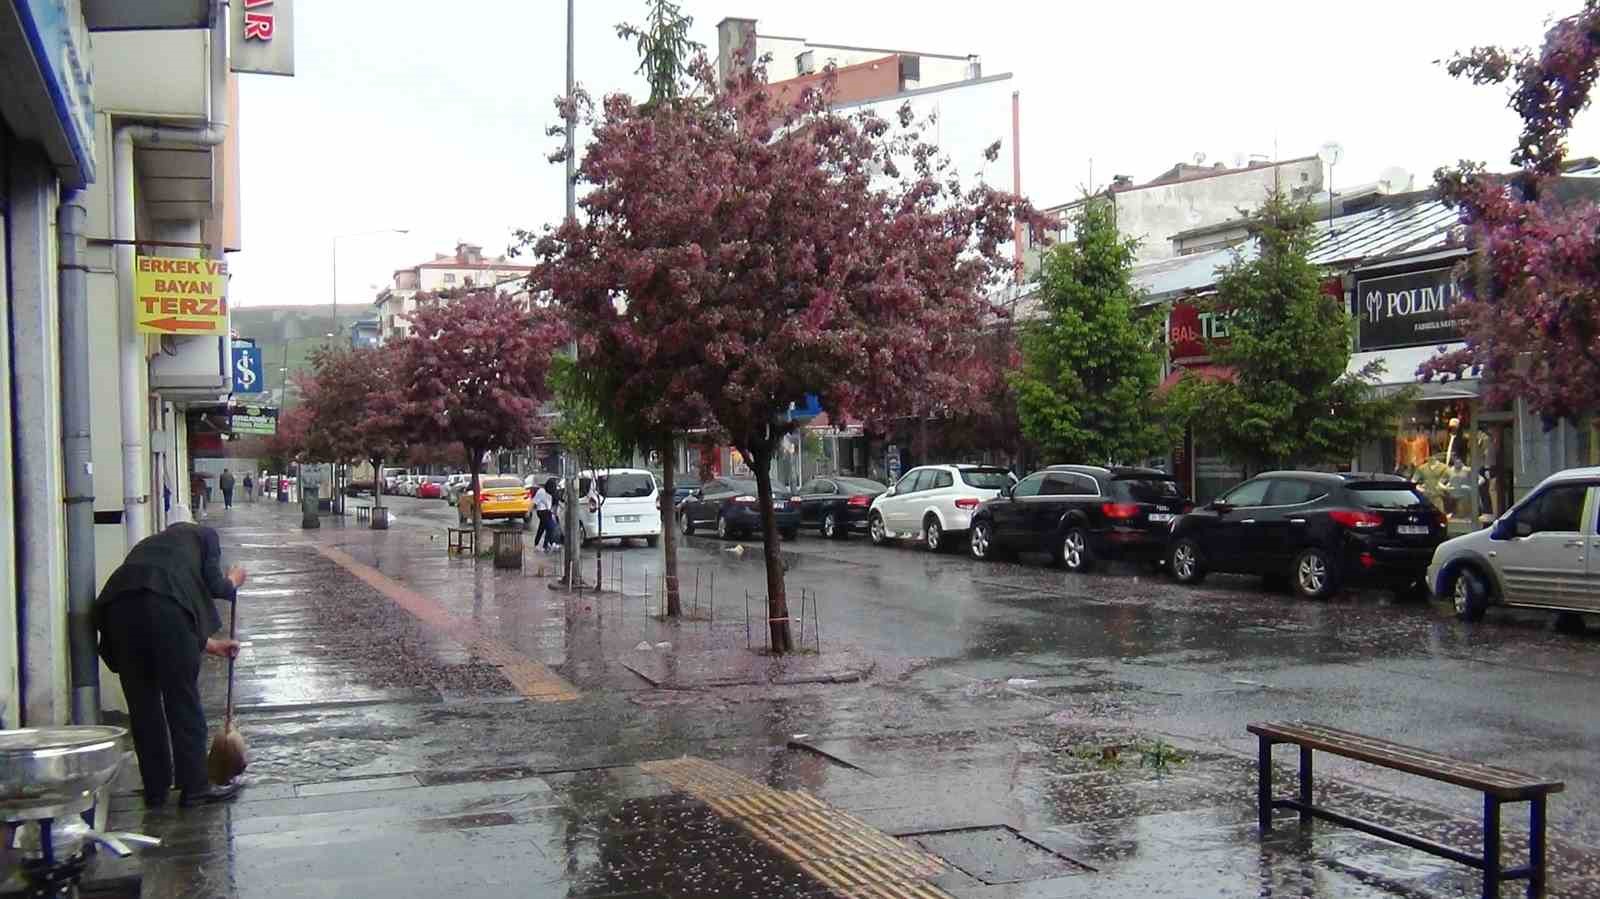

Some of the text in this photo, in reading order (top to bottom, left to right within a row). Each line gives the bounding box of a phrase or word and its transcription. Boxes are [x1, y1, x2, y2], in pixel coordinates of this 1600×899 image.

[139, 258, 228, 276] ERKEK VE
[154, 279, 214, 295] BAYAN
